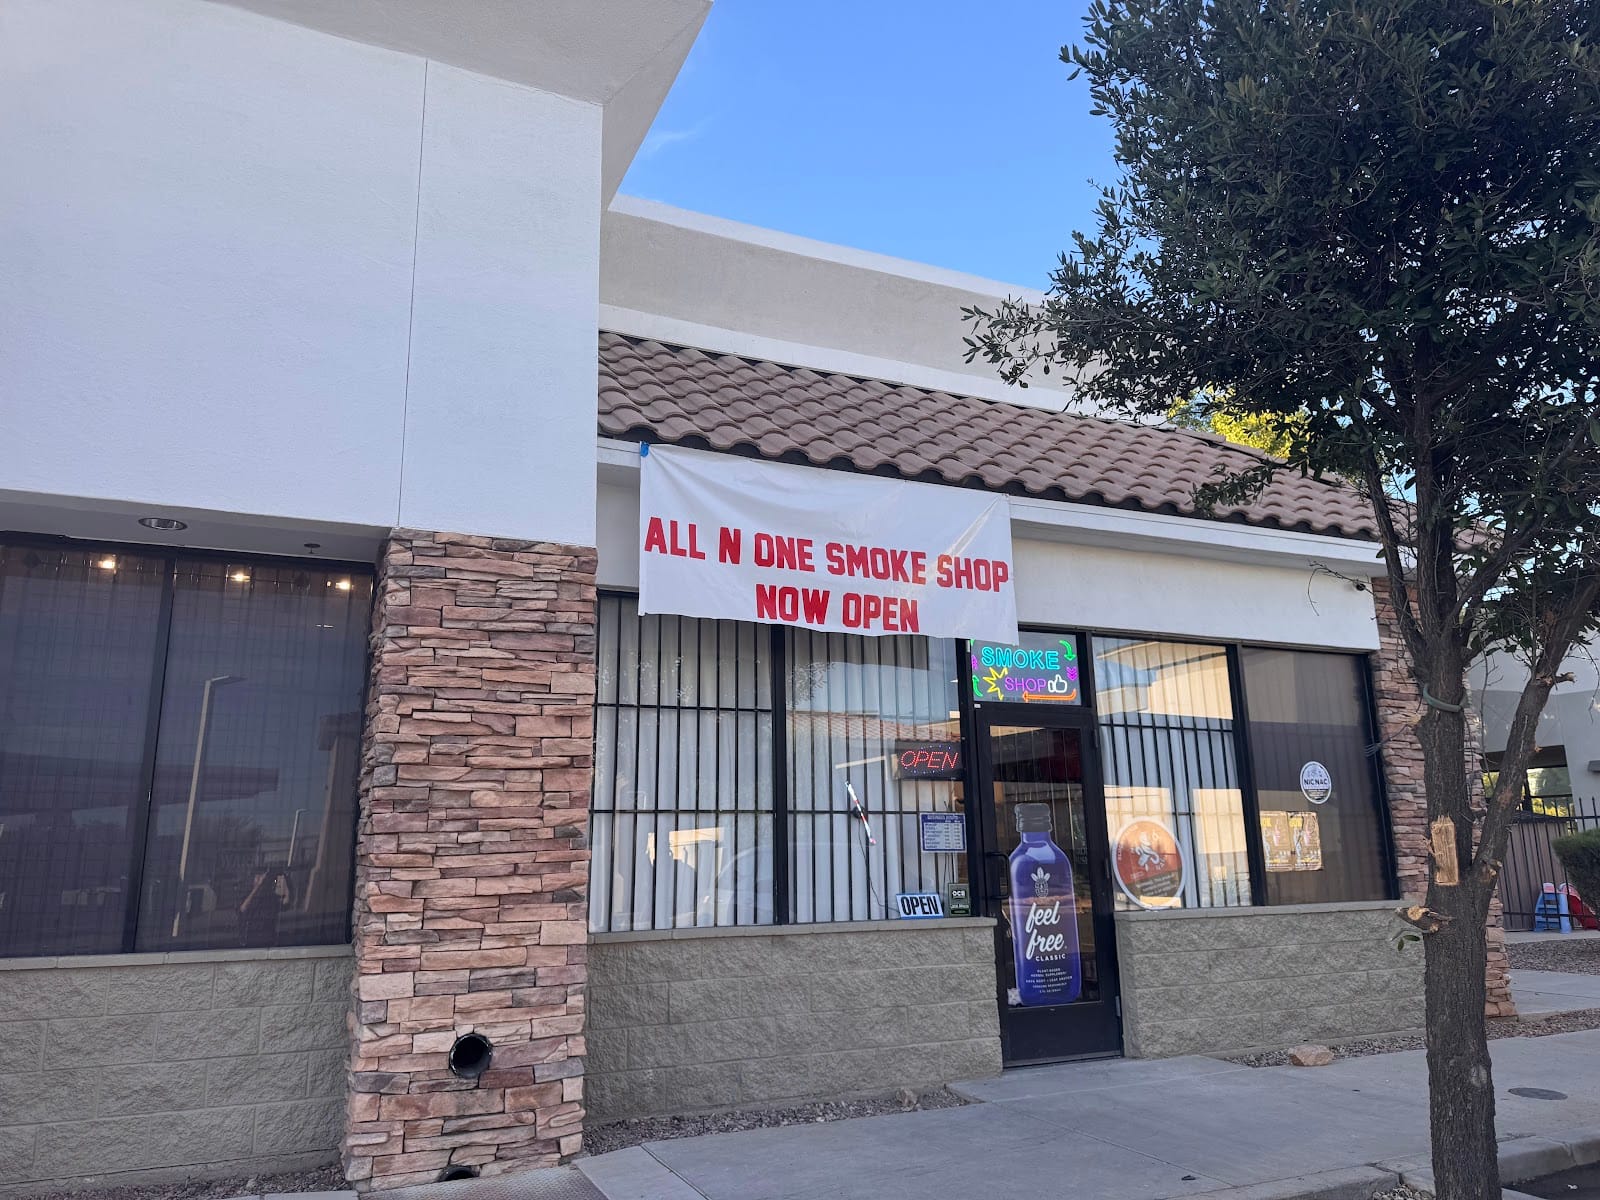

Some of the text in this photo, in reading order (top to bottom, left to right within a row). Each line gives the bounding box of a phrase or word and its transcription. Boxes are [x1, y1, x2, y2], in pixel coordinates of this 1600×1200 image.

[644, 516, 1009, 592] ALL N ONE SMOKE SHOP
[755, 583, 920, 633] NOW OPEN
[981, 646, 1061, 670] SMOKE
[1004, 676, 1047, 693] SHOP
[900, 750, 959, 769] OPEN
[900, 895, 940, 916] OPEN
[1025, 901, 1061, 933] feel
[1026, 929, 1065, 960] free
[1035, 953, 1066, 962] CLASSIC
